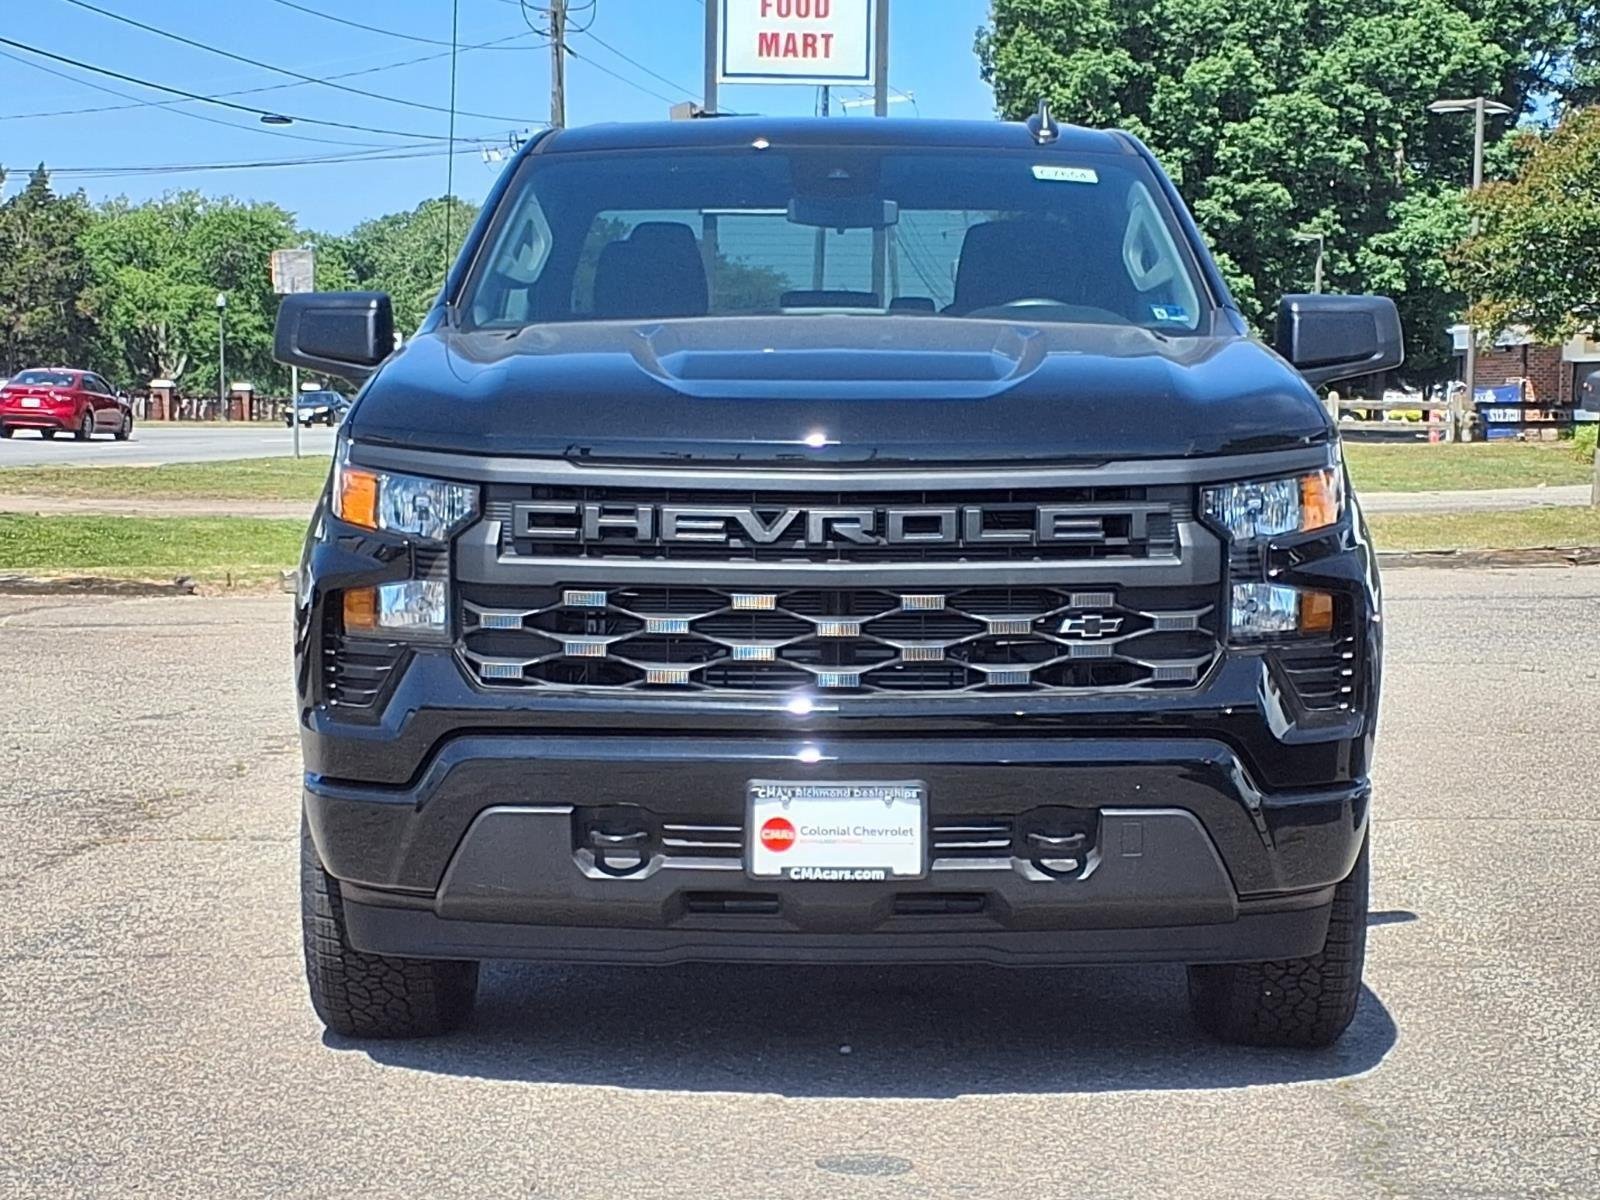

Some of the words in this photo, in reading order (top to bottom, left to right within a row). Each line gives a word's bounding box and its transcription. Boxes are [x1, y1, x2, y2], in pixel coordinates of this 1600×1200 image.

[760, 0, 830, 18] FOOD
[758, 32, 834, 59] MART
[513, 501, 1171, 544] CHEVROLET
[795, 786, 850, 799] Richmond
[800, 825, 850, 837] Colonial
[853, 826, 914, 838] Chevrolet
[789, 867, 885, 881] CMAcars.com
